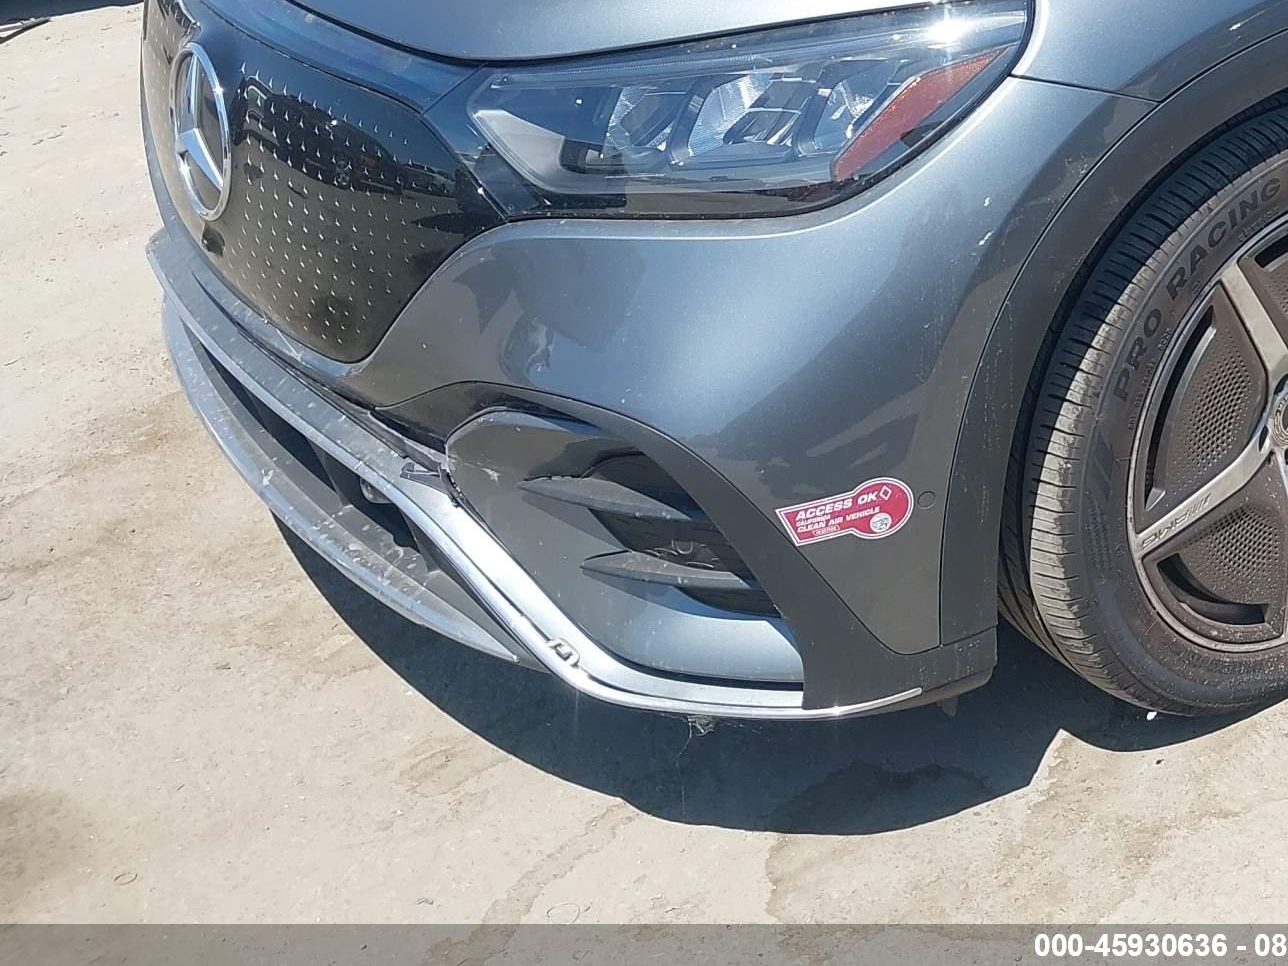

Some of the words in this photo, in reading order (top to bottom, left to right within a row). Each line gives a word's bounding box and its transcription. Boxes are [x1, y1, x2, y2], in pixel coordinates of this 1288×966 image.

[1114, 307, 1162, 402] PRO
[1166, 177, 1281, 301] RACING
[795, 498, 853, 521] ACCESS
[857, 491, 879, 505] OK
[797, 521, 827, 533] CLEAN
[828, 516, 844, 527] AIR
[845, 506, 881, 522] VEHICLE
